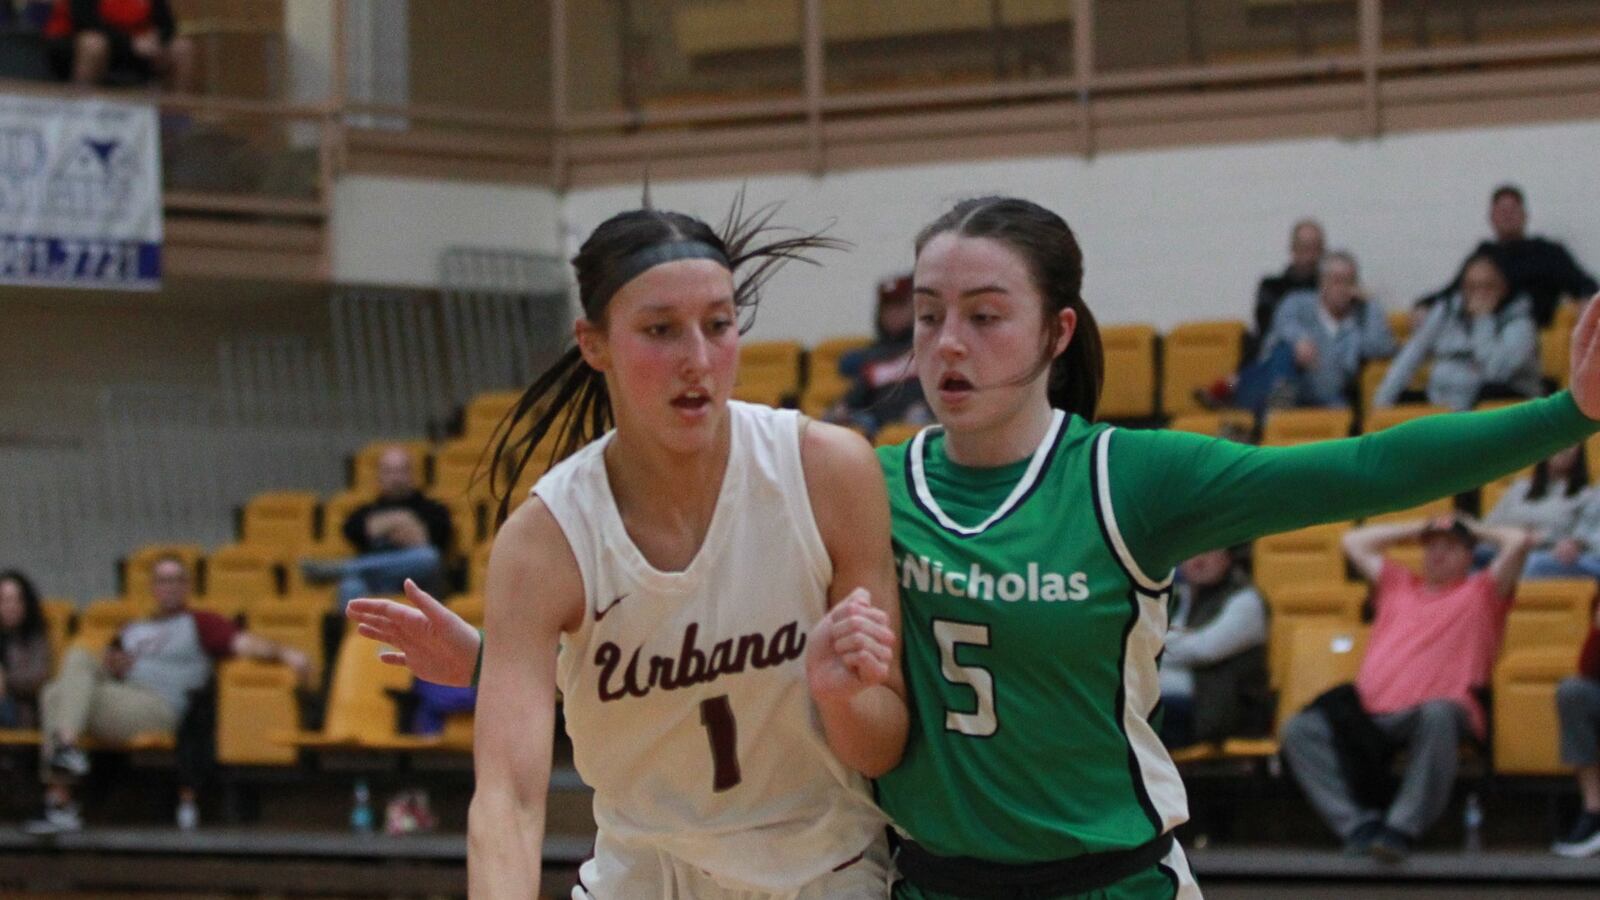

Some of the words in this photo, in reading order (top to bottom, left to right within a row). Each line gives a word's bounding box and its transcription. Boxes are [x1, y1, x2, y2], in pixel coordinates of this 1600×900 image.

[896, 552, 1090, 602] Nicholas
[594, 621, 806, 702] Urbana
[933, 617, 998, 737] 5
[699, 694, 742, 793] 1
